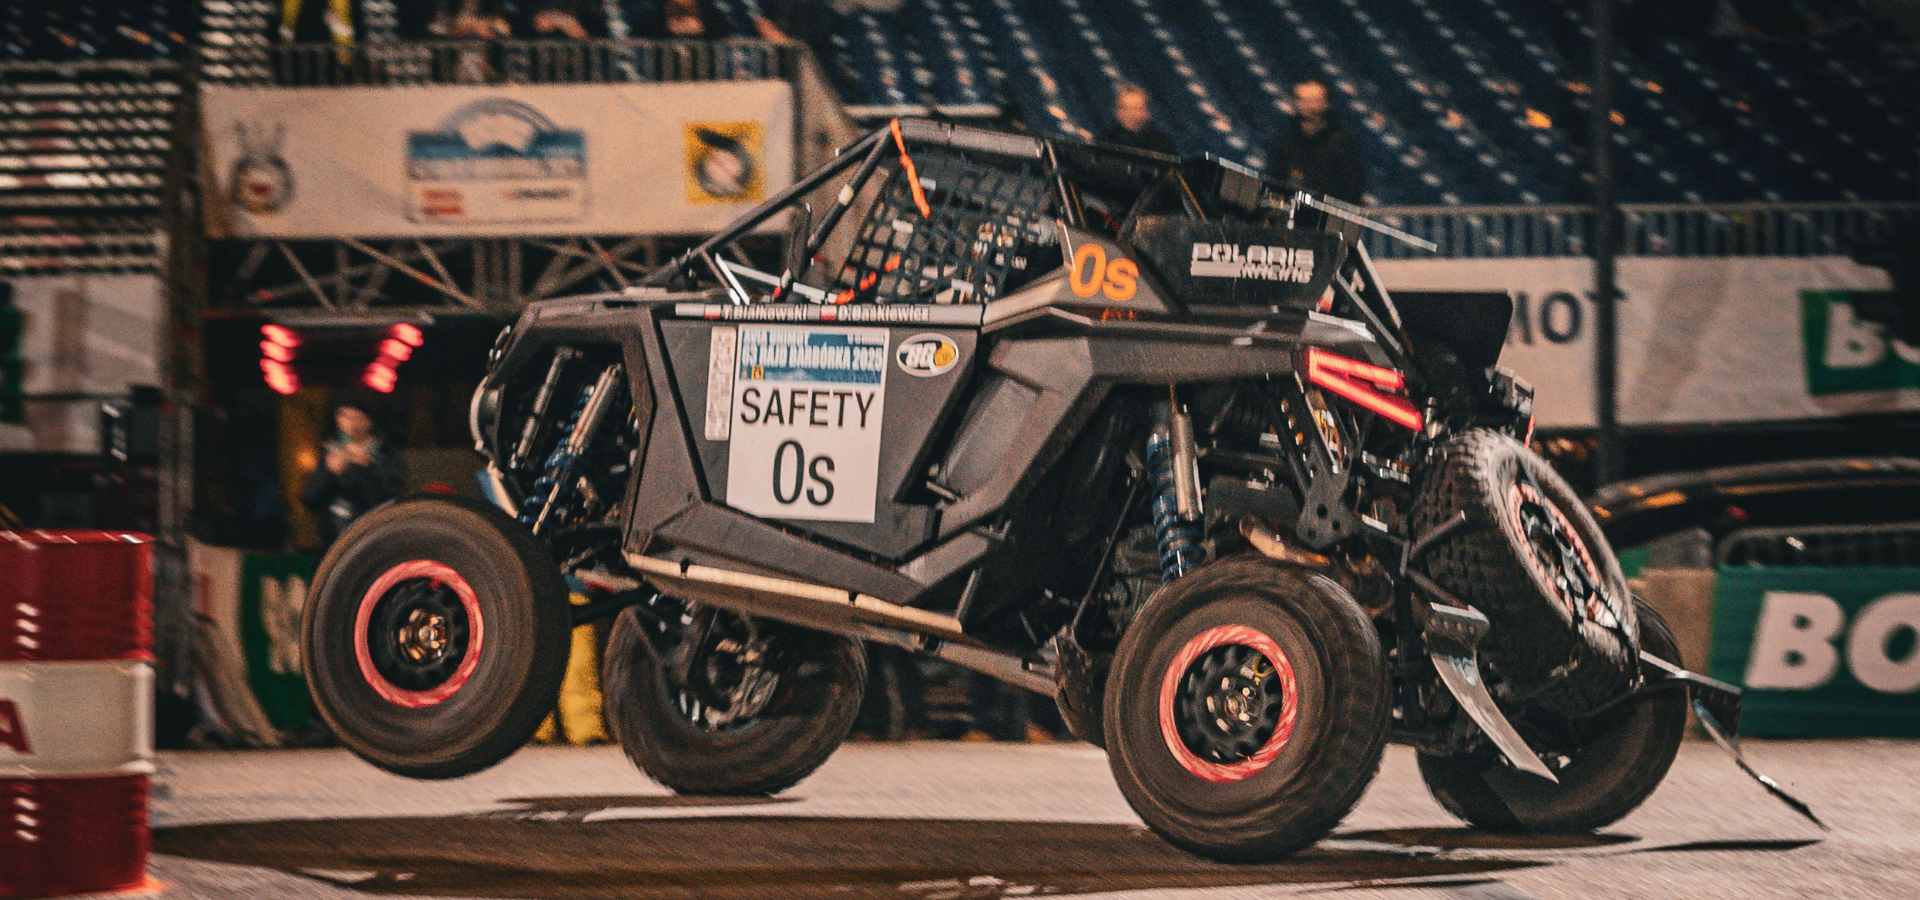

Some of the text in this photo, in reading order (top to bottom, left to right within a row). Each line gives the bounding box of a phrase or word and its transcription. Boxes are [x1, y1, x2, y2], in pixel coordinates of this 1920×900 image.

[1191, 242, 1314, 268] POLARIS
[852, 345, 883, 373] 2025
[739, 387, 876, 429] SAFETY
